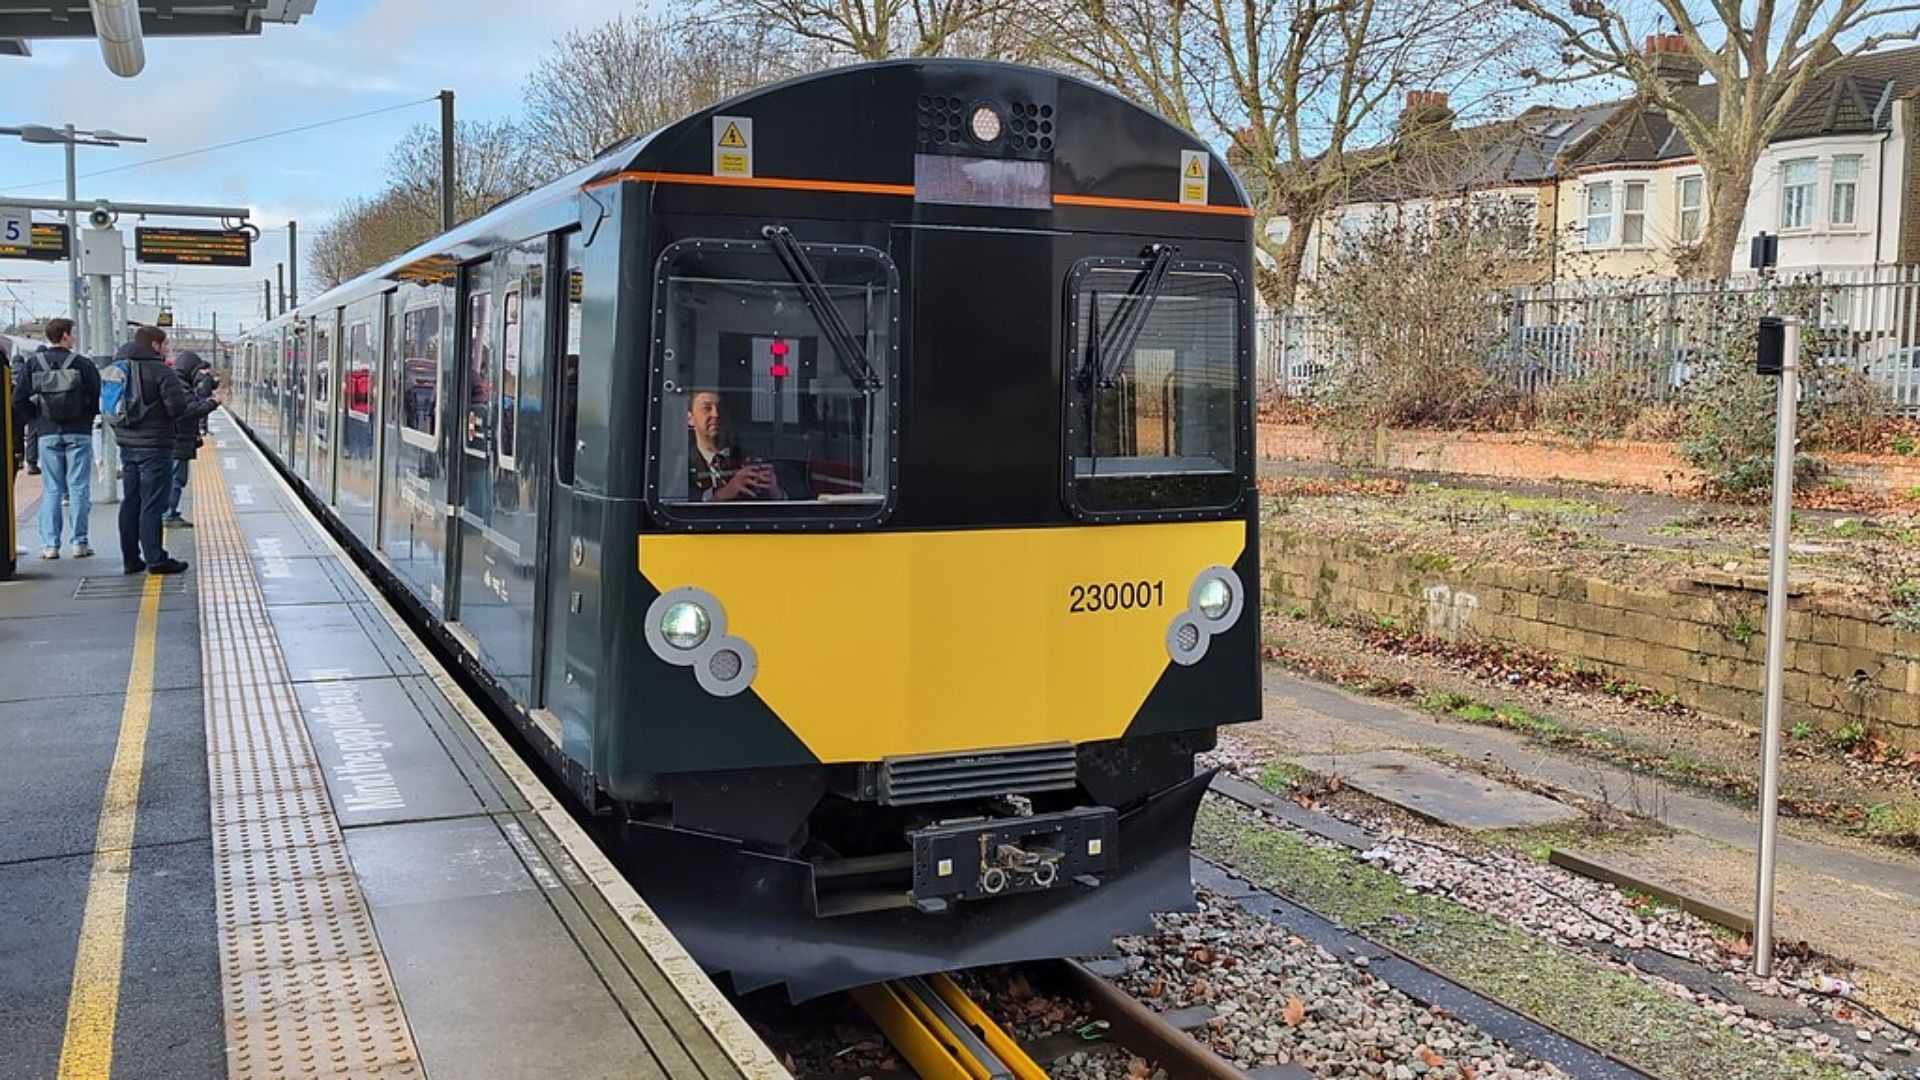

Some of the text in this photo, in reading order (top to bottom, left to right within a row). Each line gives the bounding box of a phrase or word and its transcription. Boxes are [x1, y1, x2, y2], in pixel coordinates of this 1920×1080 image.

[5, 220, 20, 241] 5
[1070, 580, 1164, 612] 230001
[331, 728, 406, 812] Mind the gap
